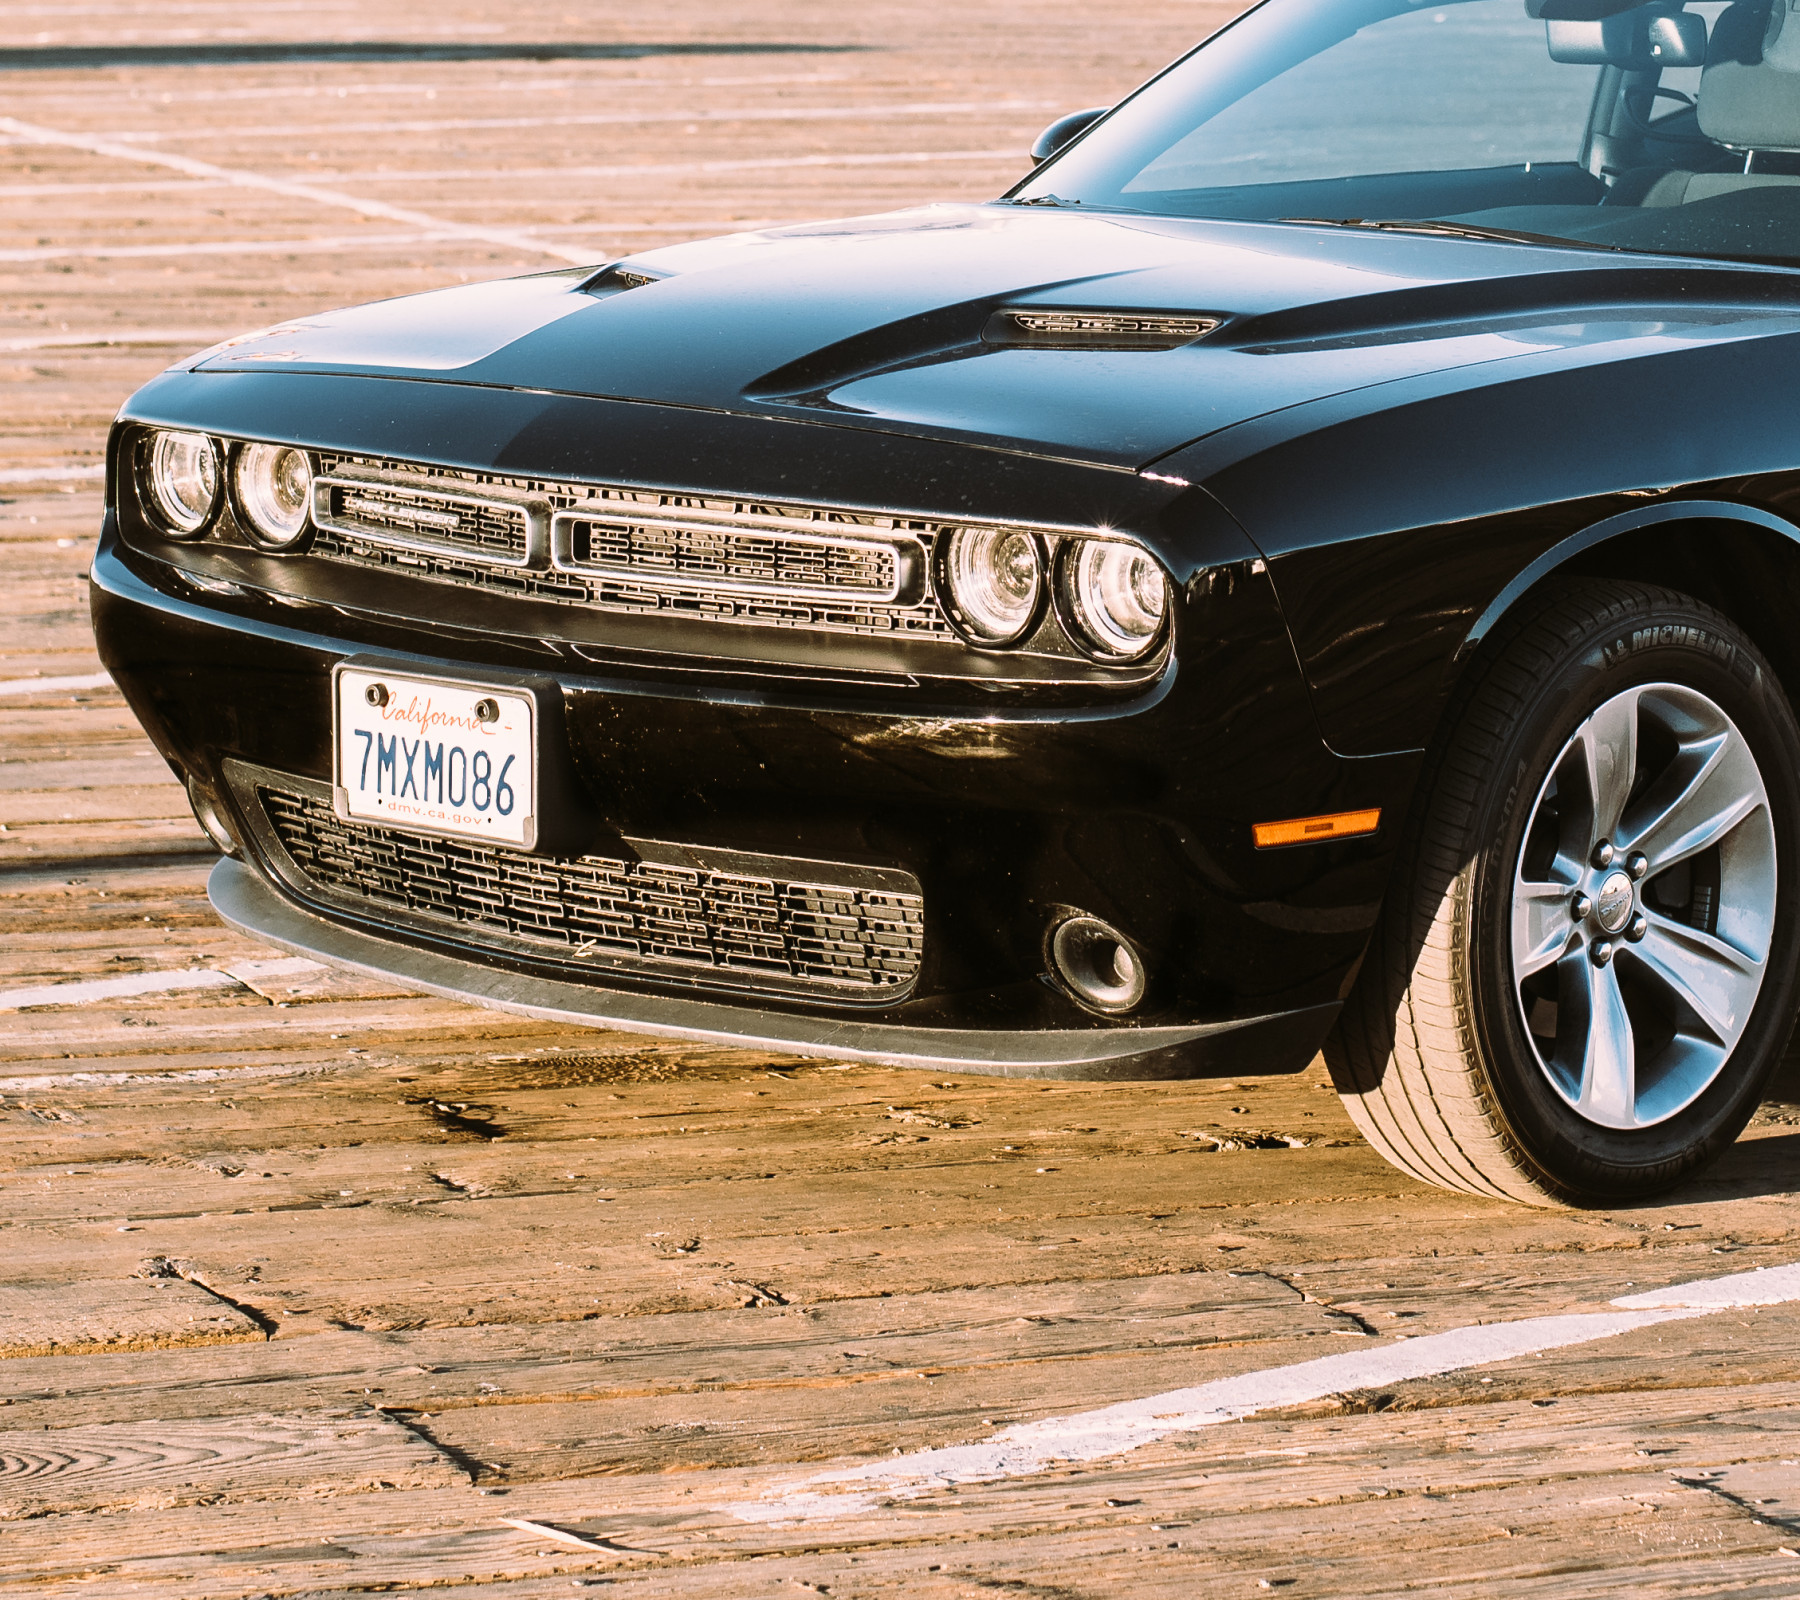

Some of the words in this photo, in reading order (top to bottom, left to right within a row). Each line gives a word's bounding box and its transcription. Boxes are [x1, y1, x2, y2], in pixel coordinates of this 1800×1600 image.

[344, 497, 460, 528] CHALLENGER
[1632, 625, 1732, 660] MICHELIN
[381, 690, 496, 735] California
[354, 728, 516, 816] 7MXM086
[387, 801, 483, 825] dmv.ca.gov
